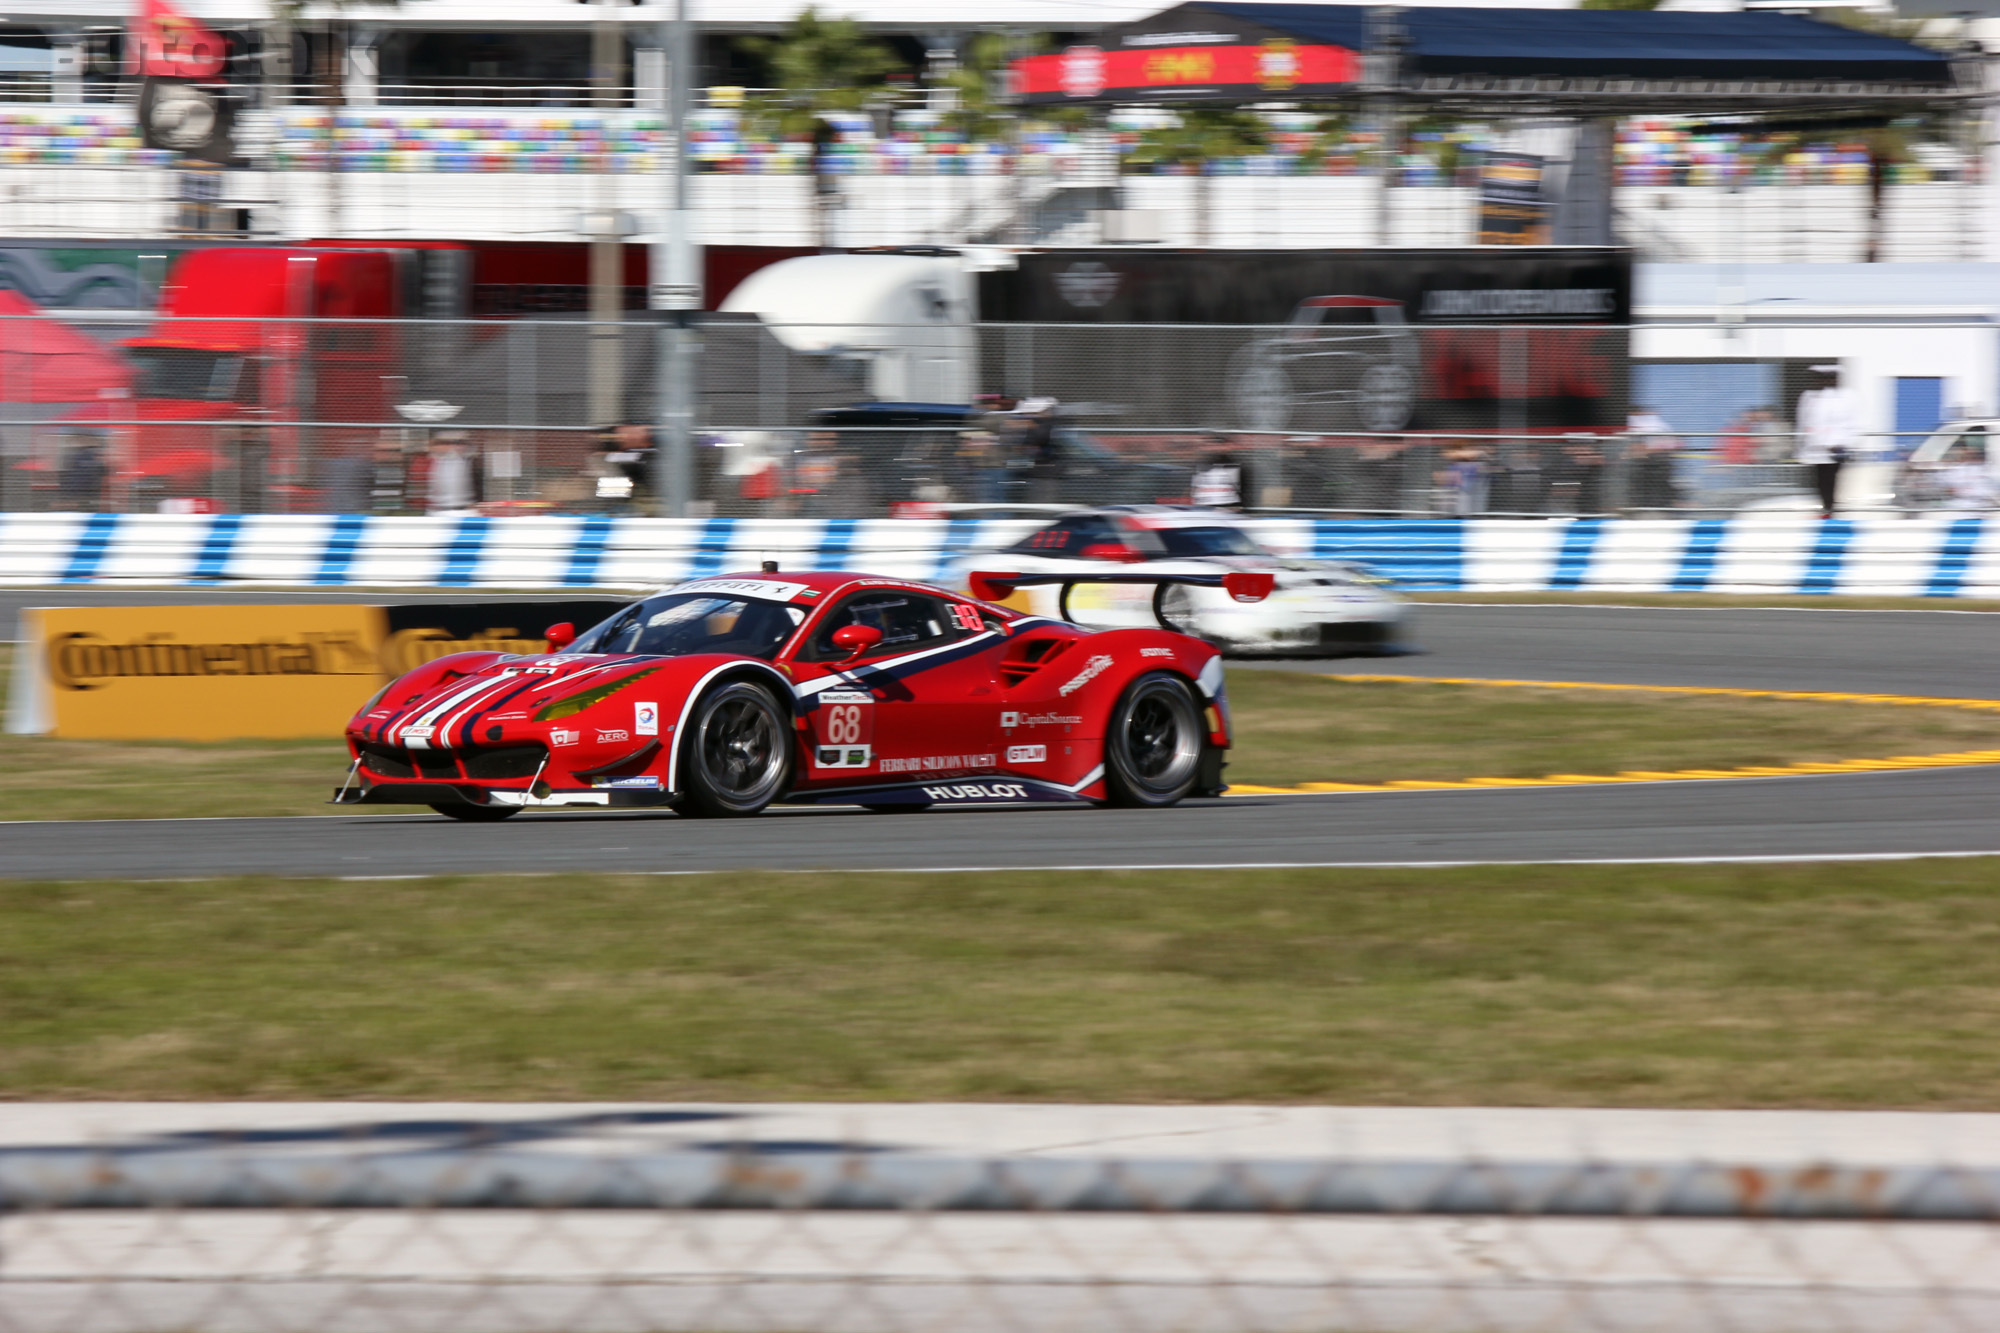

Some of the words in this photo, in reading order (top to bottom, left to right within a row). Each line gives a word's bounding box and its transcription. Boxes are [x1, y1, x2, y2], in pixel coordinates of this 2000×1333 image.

[828, 705, 861, 744] 68
[597, 732, 628, 741] AERO
[922, 784, 1029, 800] HUBLOT
